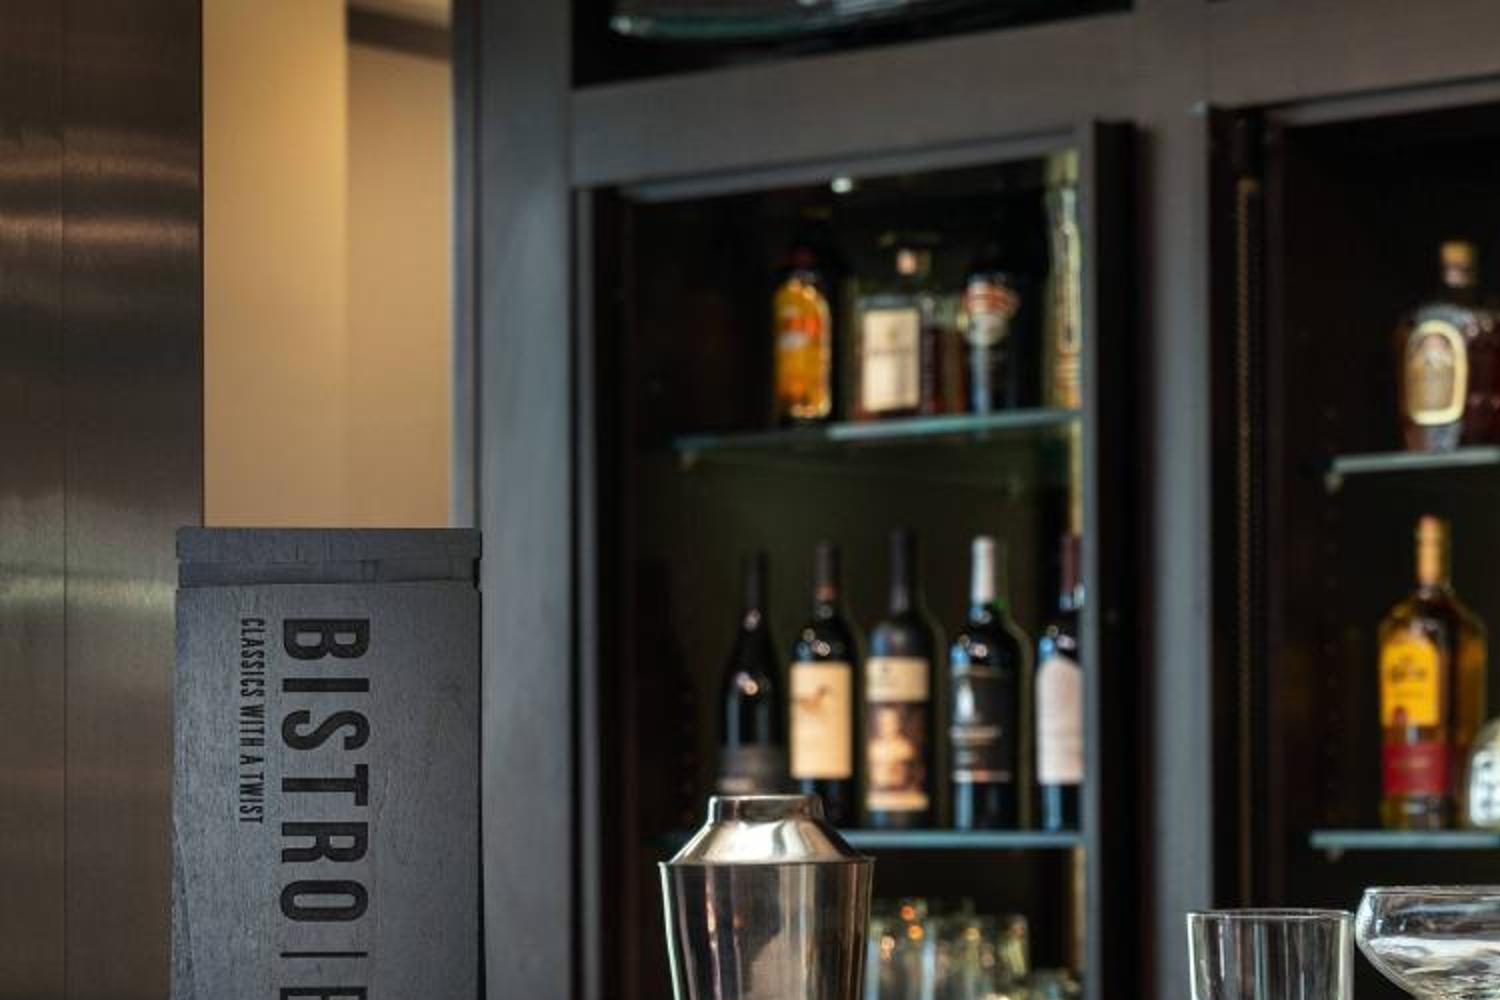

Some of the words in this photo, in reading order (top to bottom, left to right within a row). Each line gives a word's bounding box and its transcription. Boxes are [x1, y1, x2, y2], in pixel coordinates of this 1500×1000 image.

[240, 618, 265, 697] CLASSICS
[239, 703, 265, 747] WITH
[239, 753, 265, 765] A
[279, 618, 370, 922] BISTRO
[239, 771, 265, 824] TWIST
